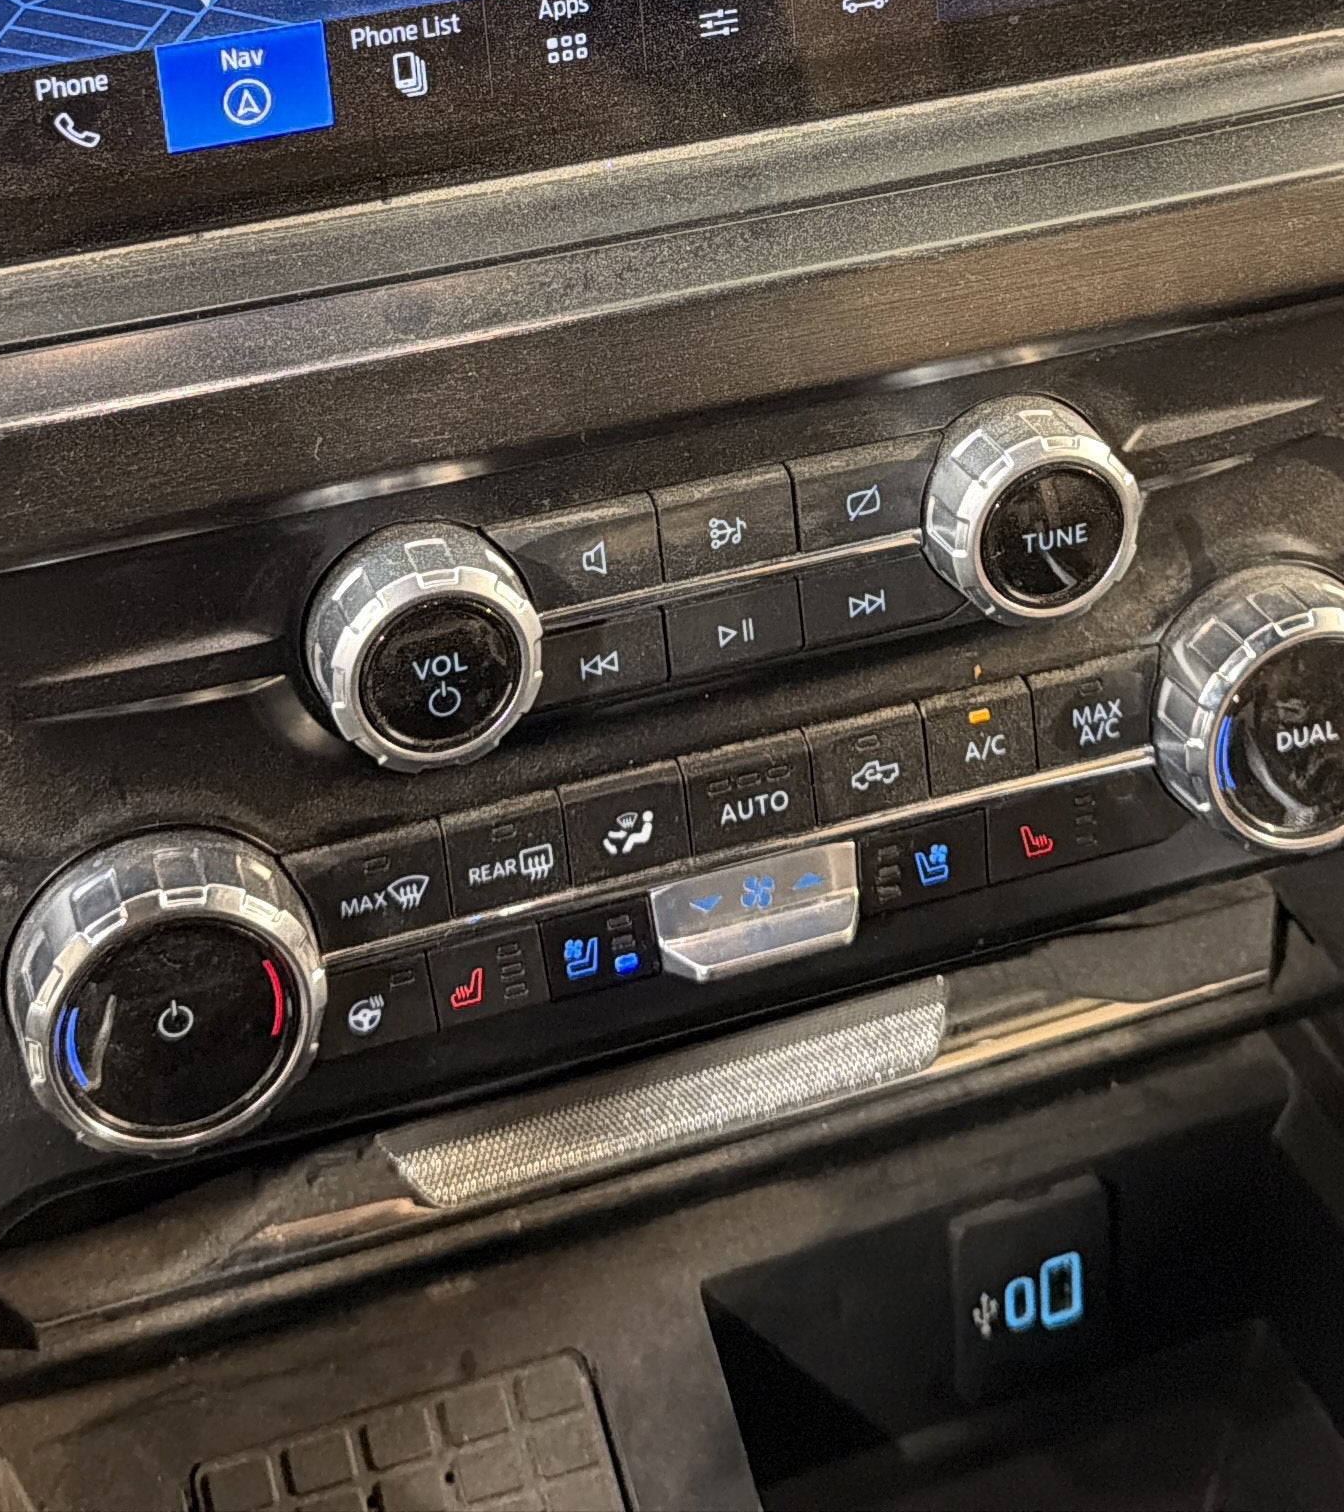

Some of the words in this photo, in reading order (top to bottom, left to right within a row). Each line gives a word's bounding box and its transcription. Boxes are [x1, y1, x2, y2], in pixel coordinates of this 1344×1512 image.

[350, 22, 419, 51] Phone
[423, 13, 462, 41] List
[220, 46, 264, 72] Nav
[34, 70, 109, 101] Phone
[1022, 522, 1089, 555] TUNE
[413, 653, 468, 681] VOL
[1072, 698, 1123, 729] MAX
[964, 733, 1007, 763] A/C
[1079, 718, 1121, 748] A/C
[1275, 720, 1340, 752] DUAL
[720, 789, 790, 826] AUTO
[468, 858, 518, 886] REAR
[340, 891, 387, 920] MAX
